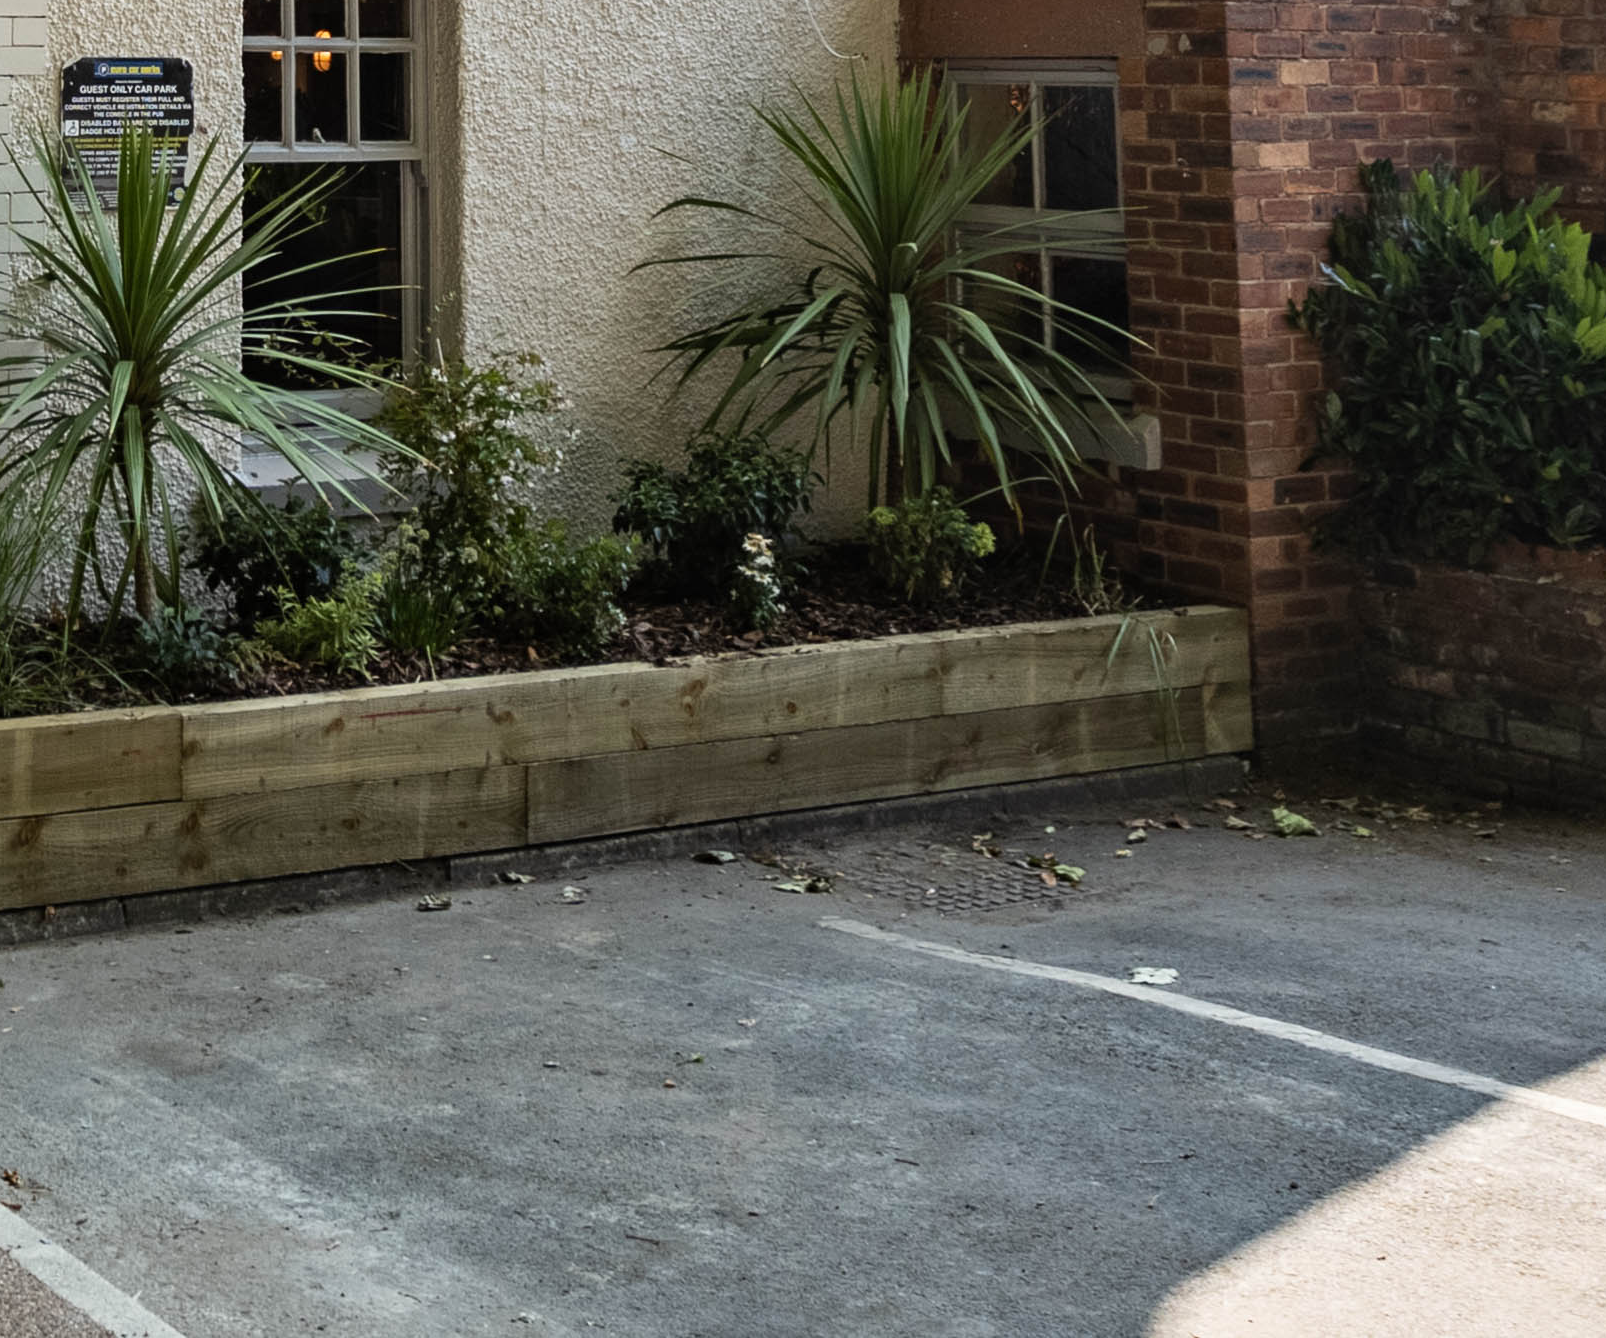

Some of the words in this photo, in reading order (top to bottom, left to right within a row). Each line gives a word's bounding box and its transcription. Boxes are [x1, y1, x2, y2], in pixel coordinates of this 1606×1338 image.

[80, 85, 107, 94] GUEST
[110, 85, 134, 94] ONLY
[134, 85, 152, 94] CAR
[154, 85, 177, 94] PARK
